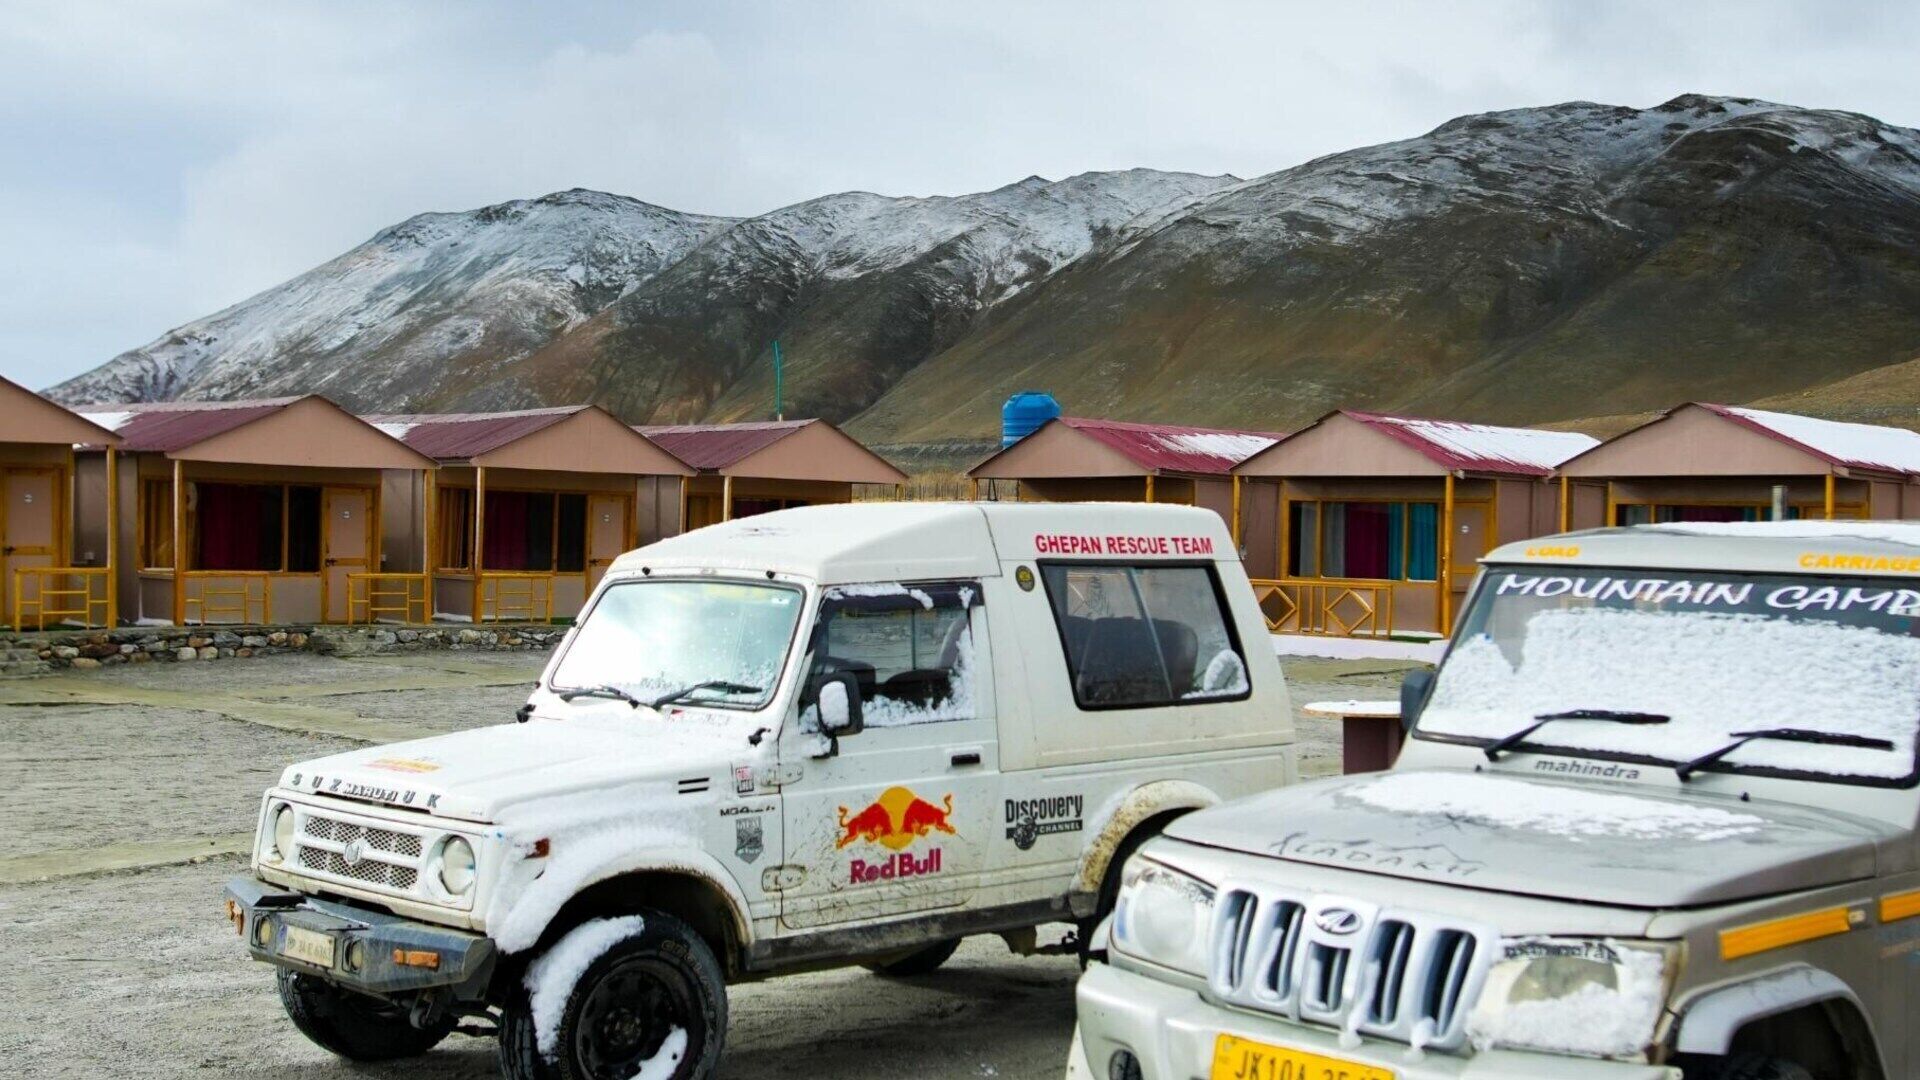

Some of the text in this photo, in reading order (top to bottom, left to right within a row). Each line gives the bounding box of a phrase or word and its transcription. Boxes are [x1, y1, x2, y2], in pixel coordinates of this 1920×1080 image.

[1035, 534, 1213, 555] GHEPAN RESCUE TEAM
[1526, 546, 1580, 558] LOAD
[1496, 573, 1920, 615] MOUNTAIN CAMP
[1535, 760, 1640, 779] mahindra
[1039, 821, 1081, 834] CHANNEL
[850, 848, 941, 884] Red Bull
